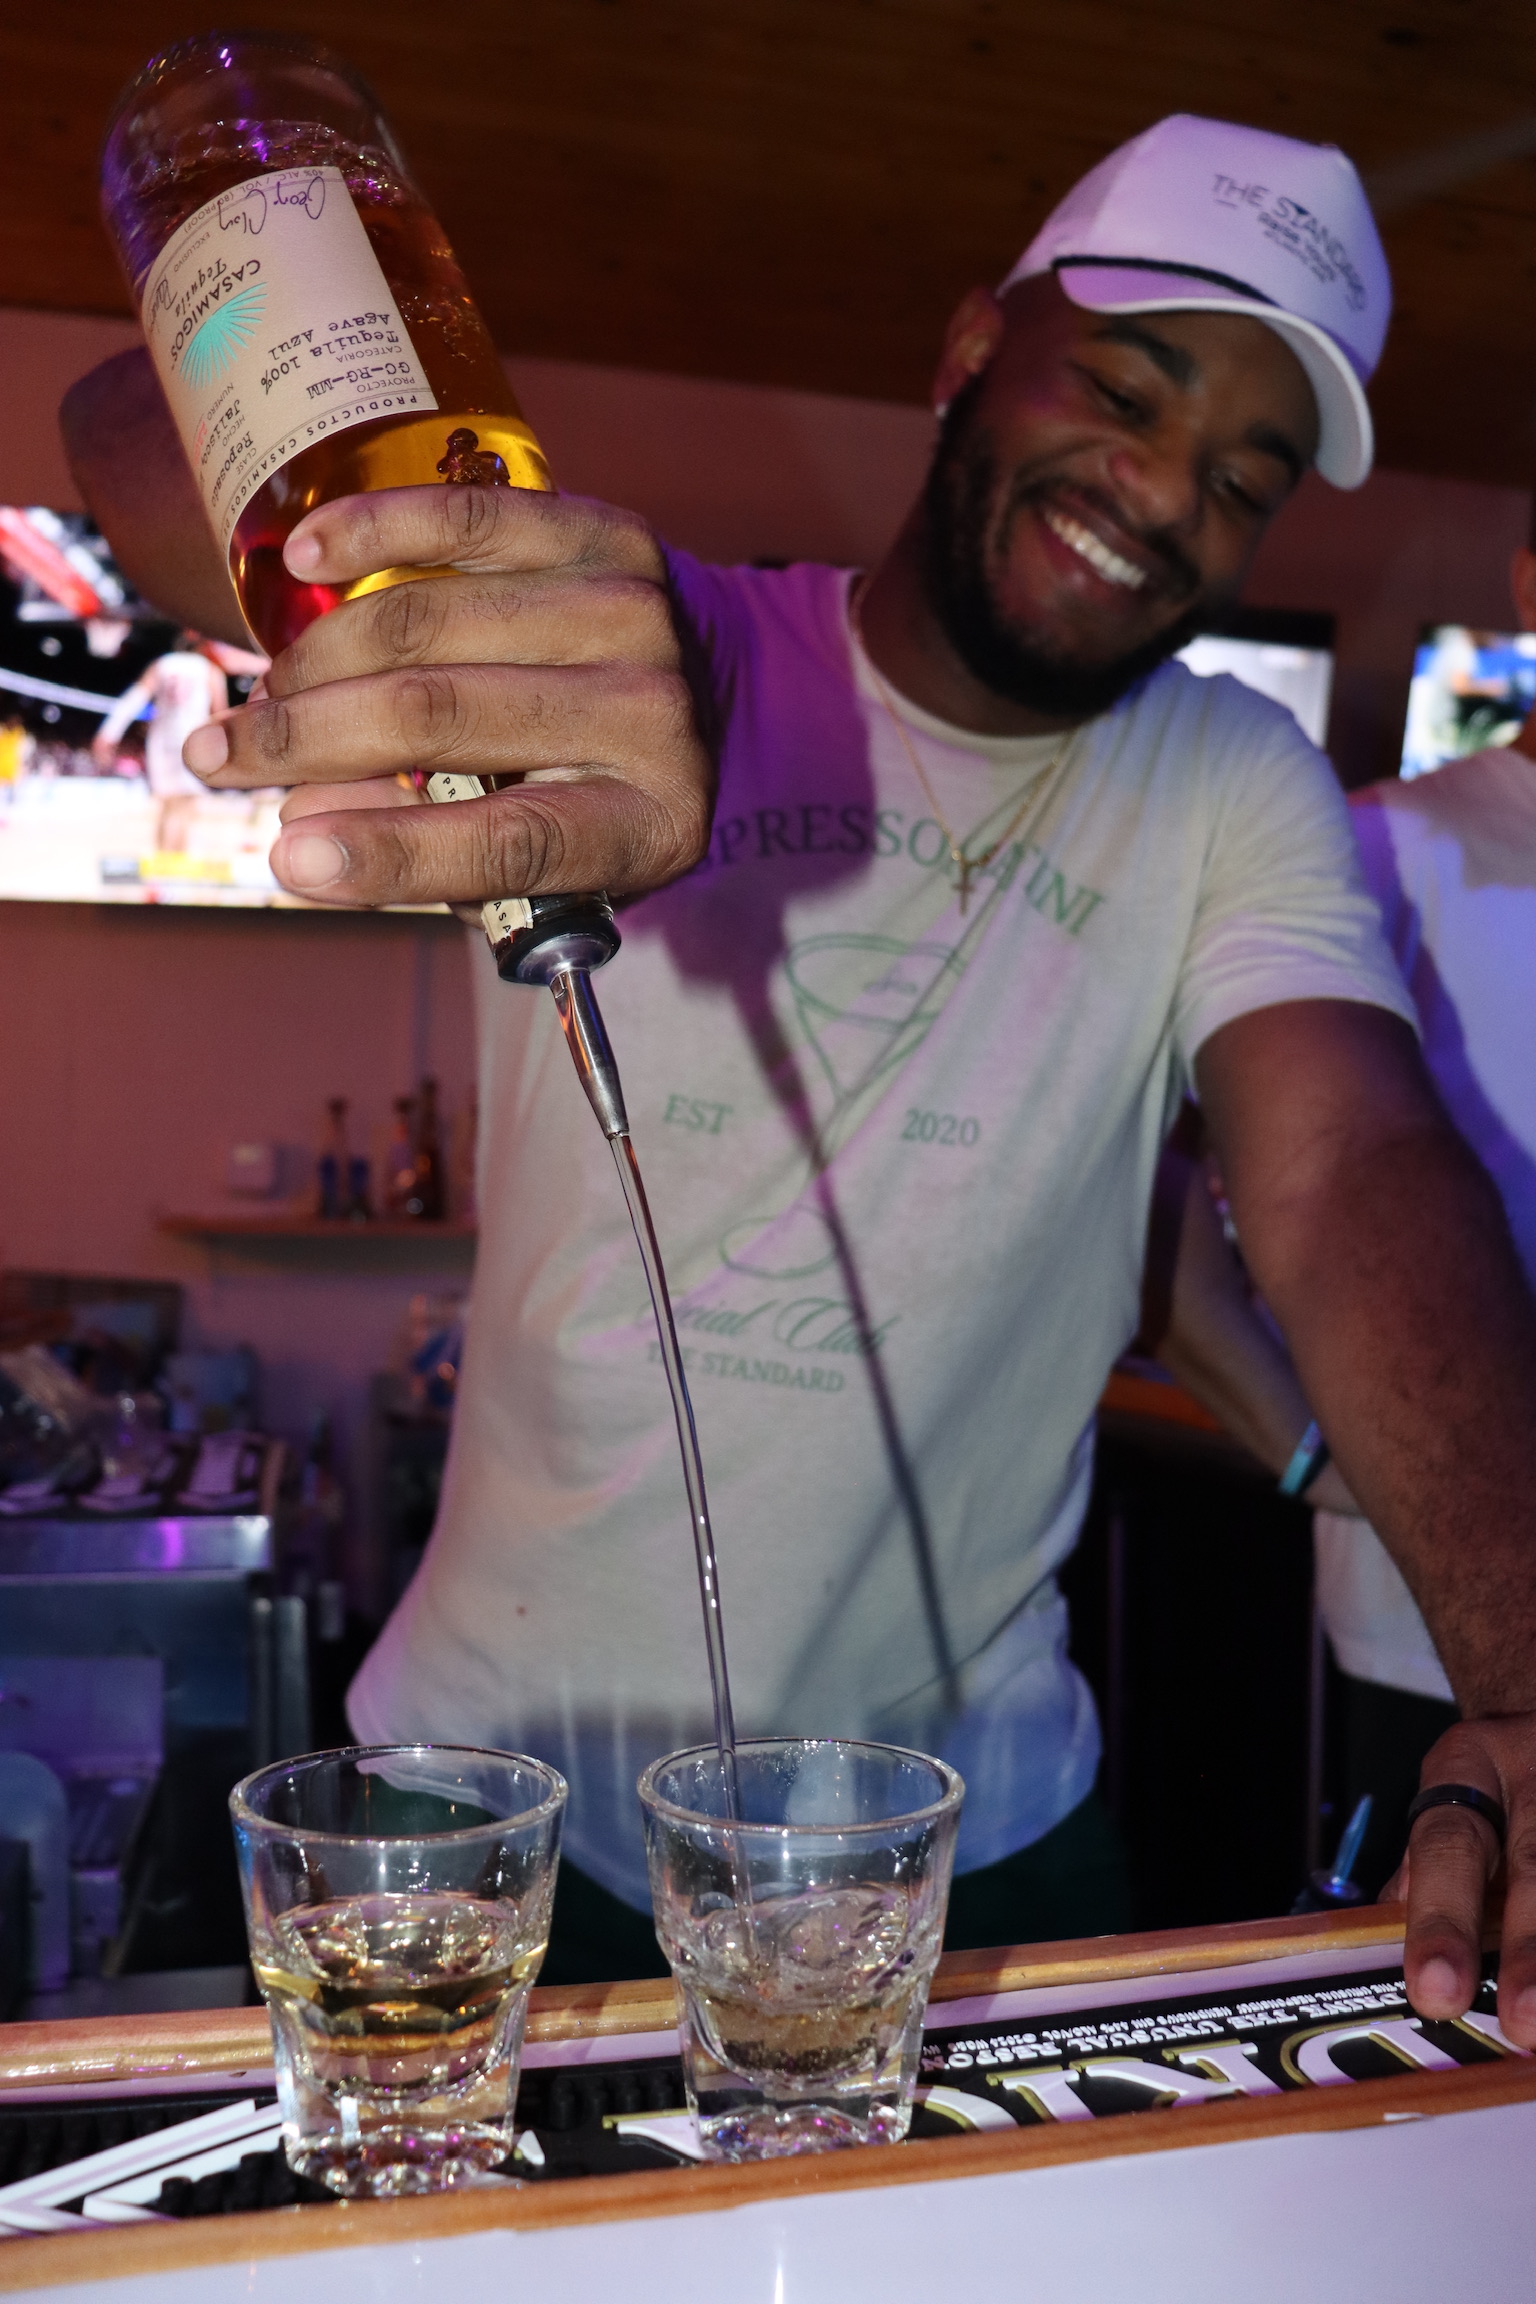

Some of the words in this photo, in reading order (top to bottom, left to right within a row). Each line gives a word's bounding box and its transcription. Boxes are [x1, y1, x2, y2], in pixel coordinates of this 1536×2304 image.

[1211, 173, 1270, 209] THE
[173, 231, 211, 274] EXCLUSIVO
[174, 257, 228, 318] Tequila
[170, 258, 261, 364] CASAMIGOS
[328, 311, 390, 332] Agave
[267, 328, 314, 361] Azul
[309, 329, 399, 358] Tequila
[335, 345, 403, 364] CATEGORIA
[260, 355, 301, 396] 100%
[356, 376, 416, 393] PROYECTO
[206, 382, 235, 422] NUMERO
[306, 395, 418, 436] PRODUCTOS
[222, 414, 247, 447] HECHO
[211, 430, 254, 508] Reposado
[231, 438, 297, 514] CASAMIGOS
[235, 447, 257, 476] CLASE
[703, 803, 950, 869] PRESSO
[663, 1094, 734, 1136] EST
[903, 1107, 981, 1147] 2020
[701, 1351, 845, 1394] STANDARD
[1226, 2008, 1299, 2030] THE
[1299, 1992, 1408, 2019] DRINK
[1067, 2019, 1225, 2053] UNUSUAL
[920, 2042, 1063, 2072] RESPON
